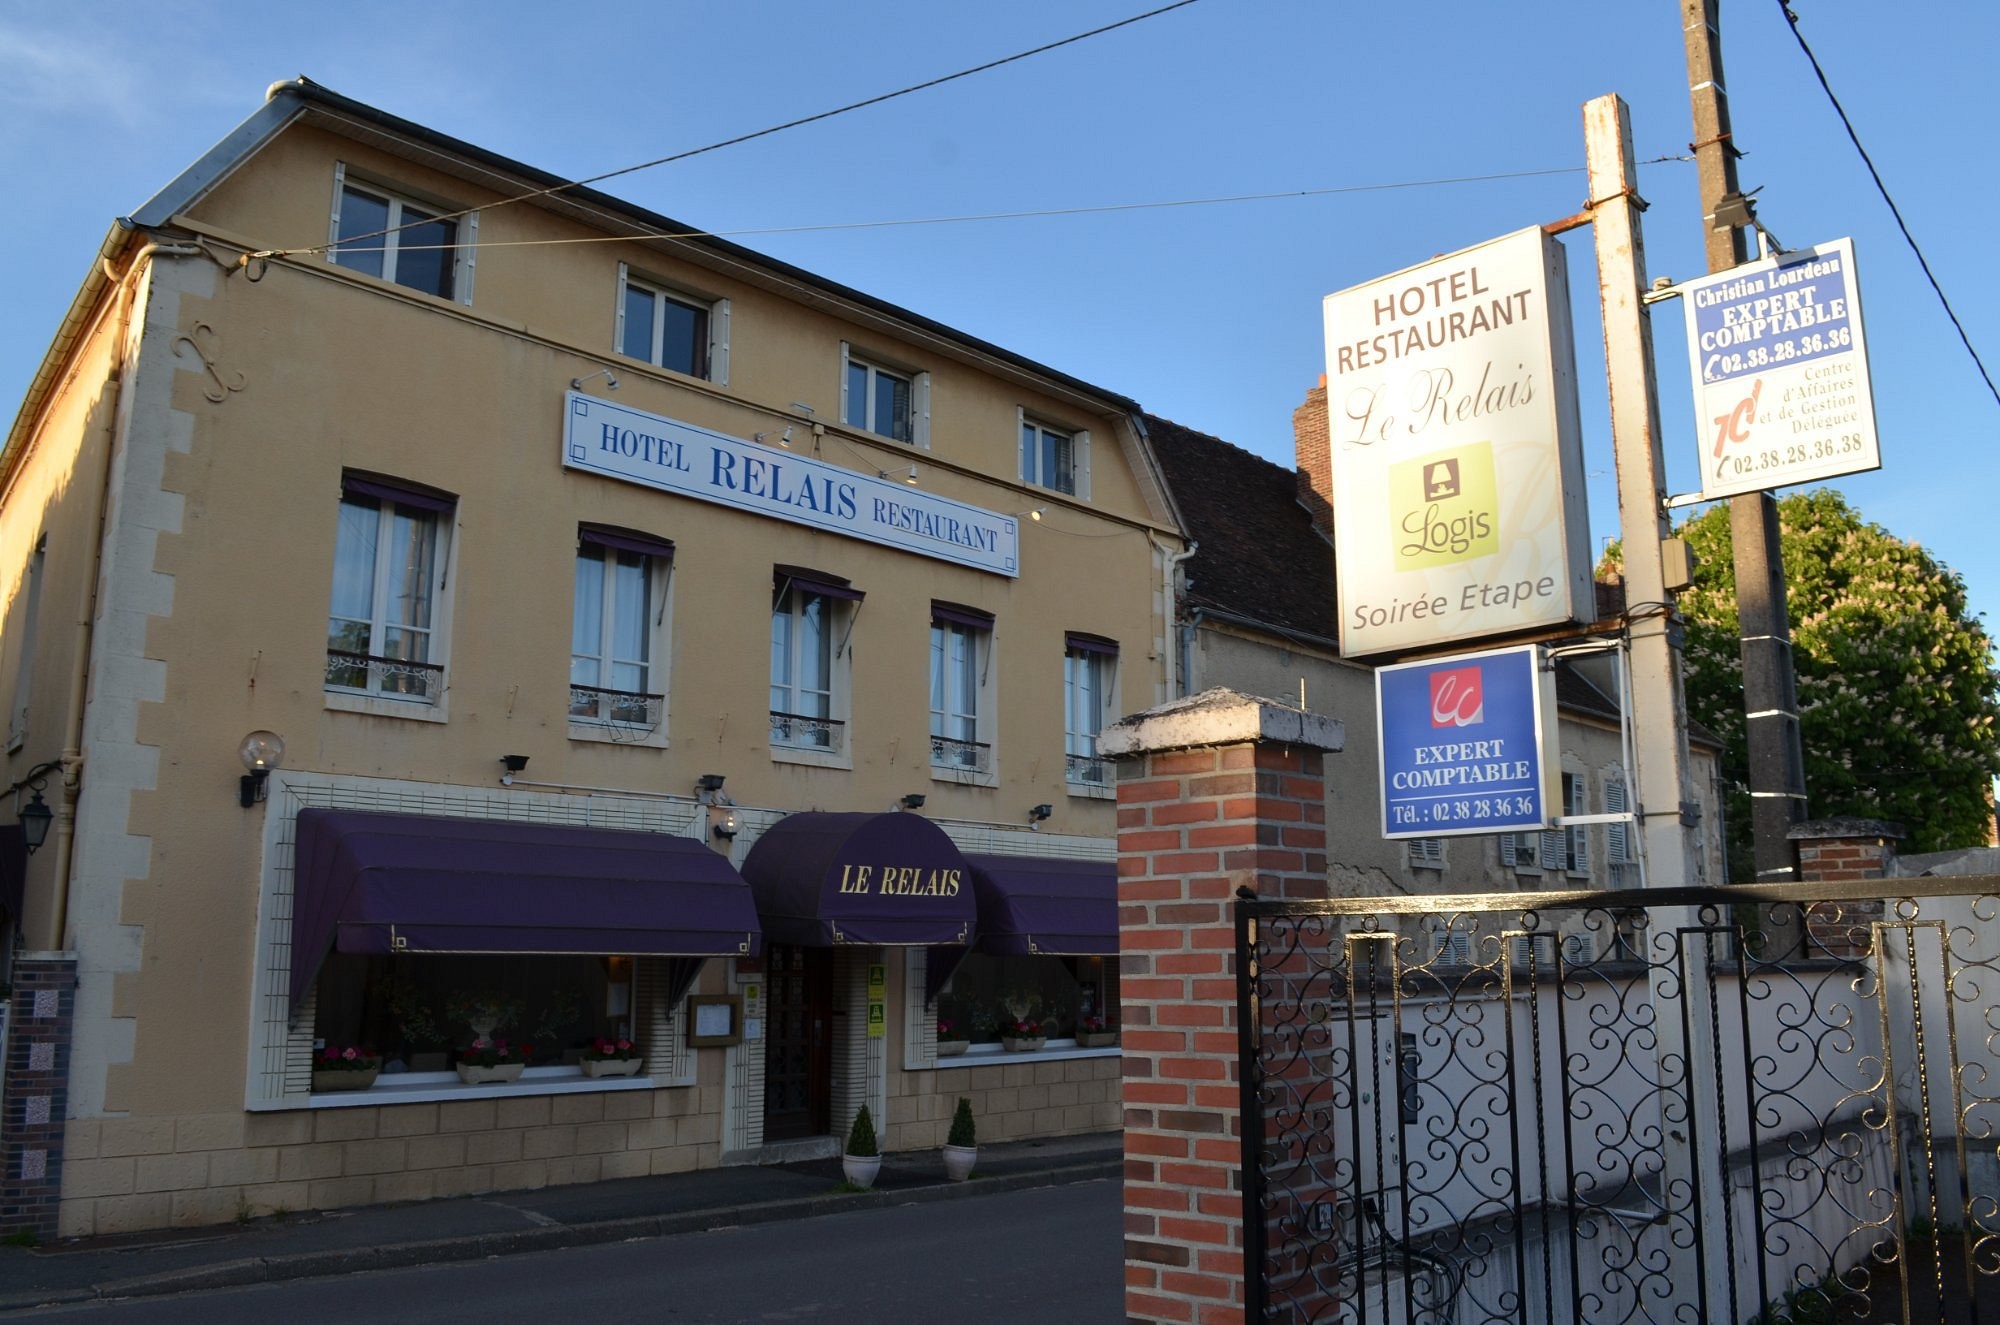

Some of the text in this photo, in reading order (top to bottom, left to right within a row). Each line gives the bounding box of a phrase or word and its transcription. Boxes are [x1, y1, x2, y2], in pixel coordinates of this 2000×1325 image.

[1374, 267, 1489, 325] HOTEL
[1695, 259, 1840, 308] Christian Lourdeau
[1701, 298, 1846, 352] COMPTABLE
[1722, 286, 1816, 327] EXPERT
[1338, 289, 1532, 374] RESTAURANT
[1783, 378, 1855, 402] d'Affaires
[1804, 361, 1852, 381] Centre
[1343, 361, 1536, 451] Le Relais
[1759, 395, 1855, 424] et de Gestion
[601, 423, 998, 553] HOTEL RELAIS RESTAURANT
[1400, 503, 1491, 557] Logis
[1353, 576, 1555, 630] Soirée Etape
[1414, 739, 1504, 765] EXPERT
[1393, 761, 1530, 790] COMPTABLE
[1433, 803, 1450, 821] 02
[1453, 801, 1470, 820] 38
[1473, 799, 1490, 818] 28
[1494, 797, 1511, 817] 36
[1515, 795, 1533, 815] 36
[839, 864, 961, 897] LE RELAIS
